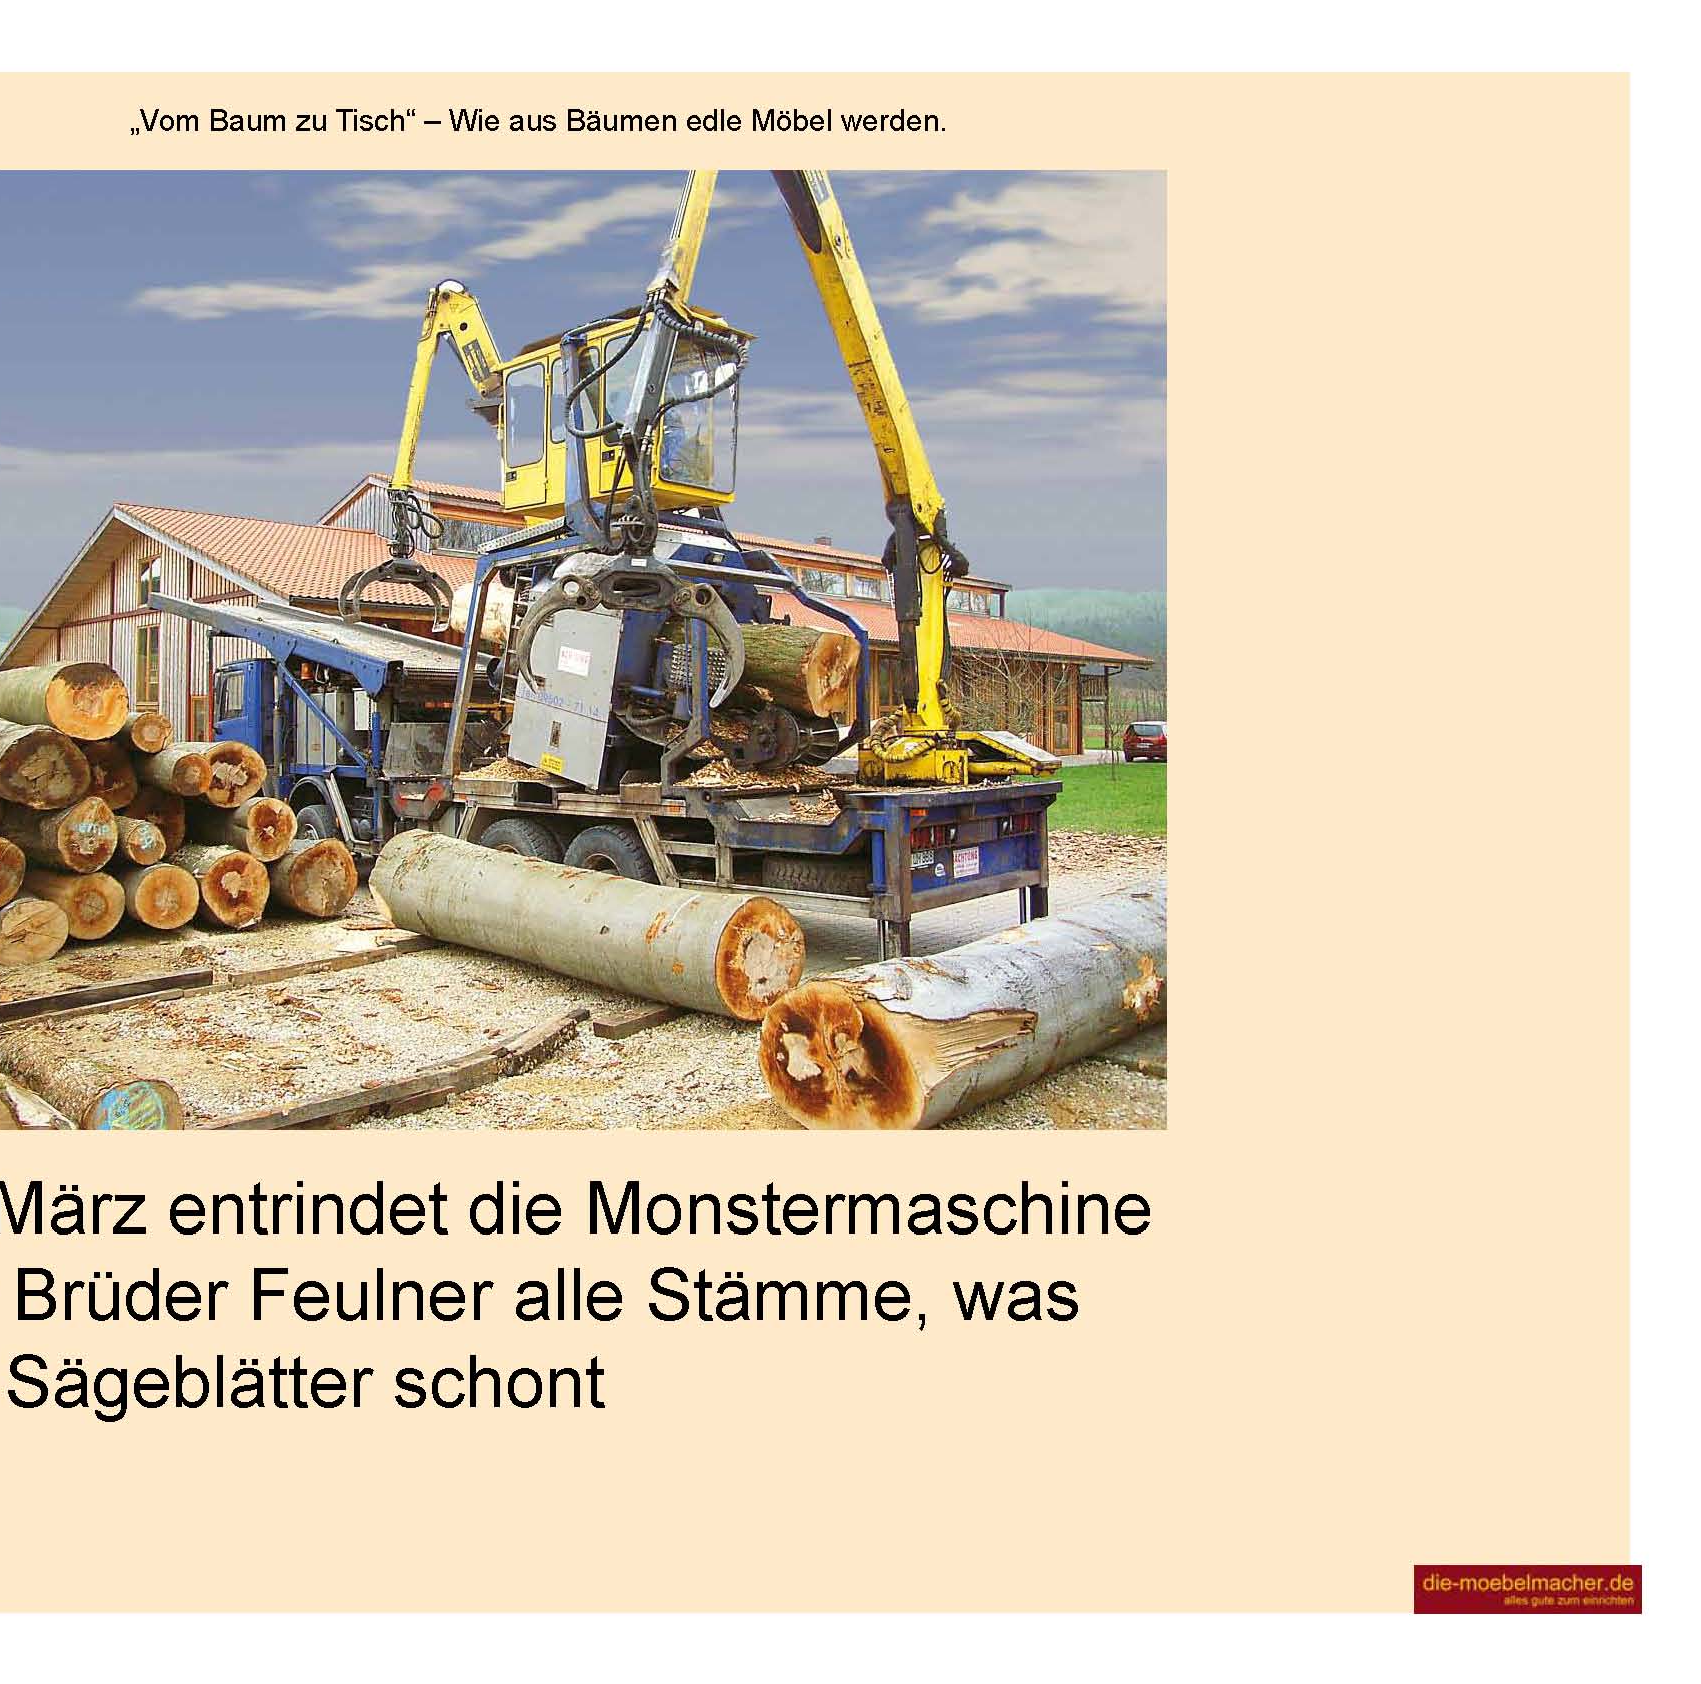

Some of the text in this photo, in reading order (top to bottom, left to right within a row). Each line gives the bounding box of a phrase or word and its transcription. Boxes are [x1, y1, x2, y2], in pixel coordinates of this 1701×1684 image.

[211, 109, 285, 131] Baum
[296, 115, 326, 131] zu
[449, 109, 499, 131] Wie
[510, 115, 556, 131] aus
[568, 109, 676, 131] Bäumen
[687, 109, 741, 131] edle
[753, 109, 831, 131] Möbel
[841, 109, 945, 131] werden.
[170, 1181, 448, 1235] entrindet
[470, 1181, 561, 1235] die
[590, 1181, 1150, 1235] Monstermaschine
[18, 1268, 229, 1321] Brüder
[254, 1268, 494, 1321] Feulner
[516, 1268, 622, 1321] alle
[649, 1267, 925, 1331] Stämme,
[953, 1281, 1078, 1321] was
[8, 1354, 374, 1422] Sägeblätter
[395, 1355, 605, 1408] schont
[1423, 1573, 1634, 1591] die-moebelmacher.de
[1504, 1595, 1529, 1606] alles
[1531, 1596, 1554, 1608] gute
[1557, 1597, 1579, 1606] zum
